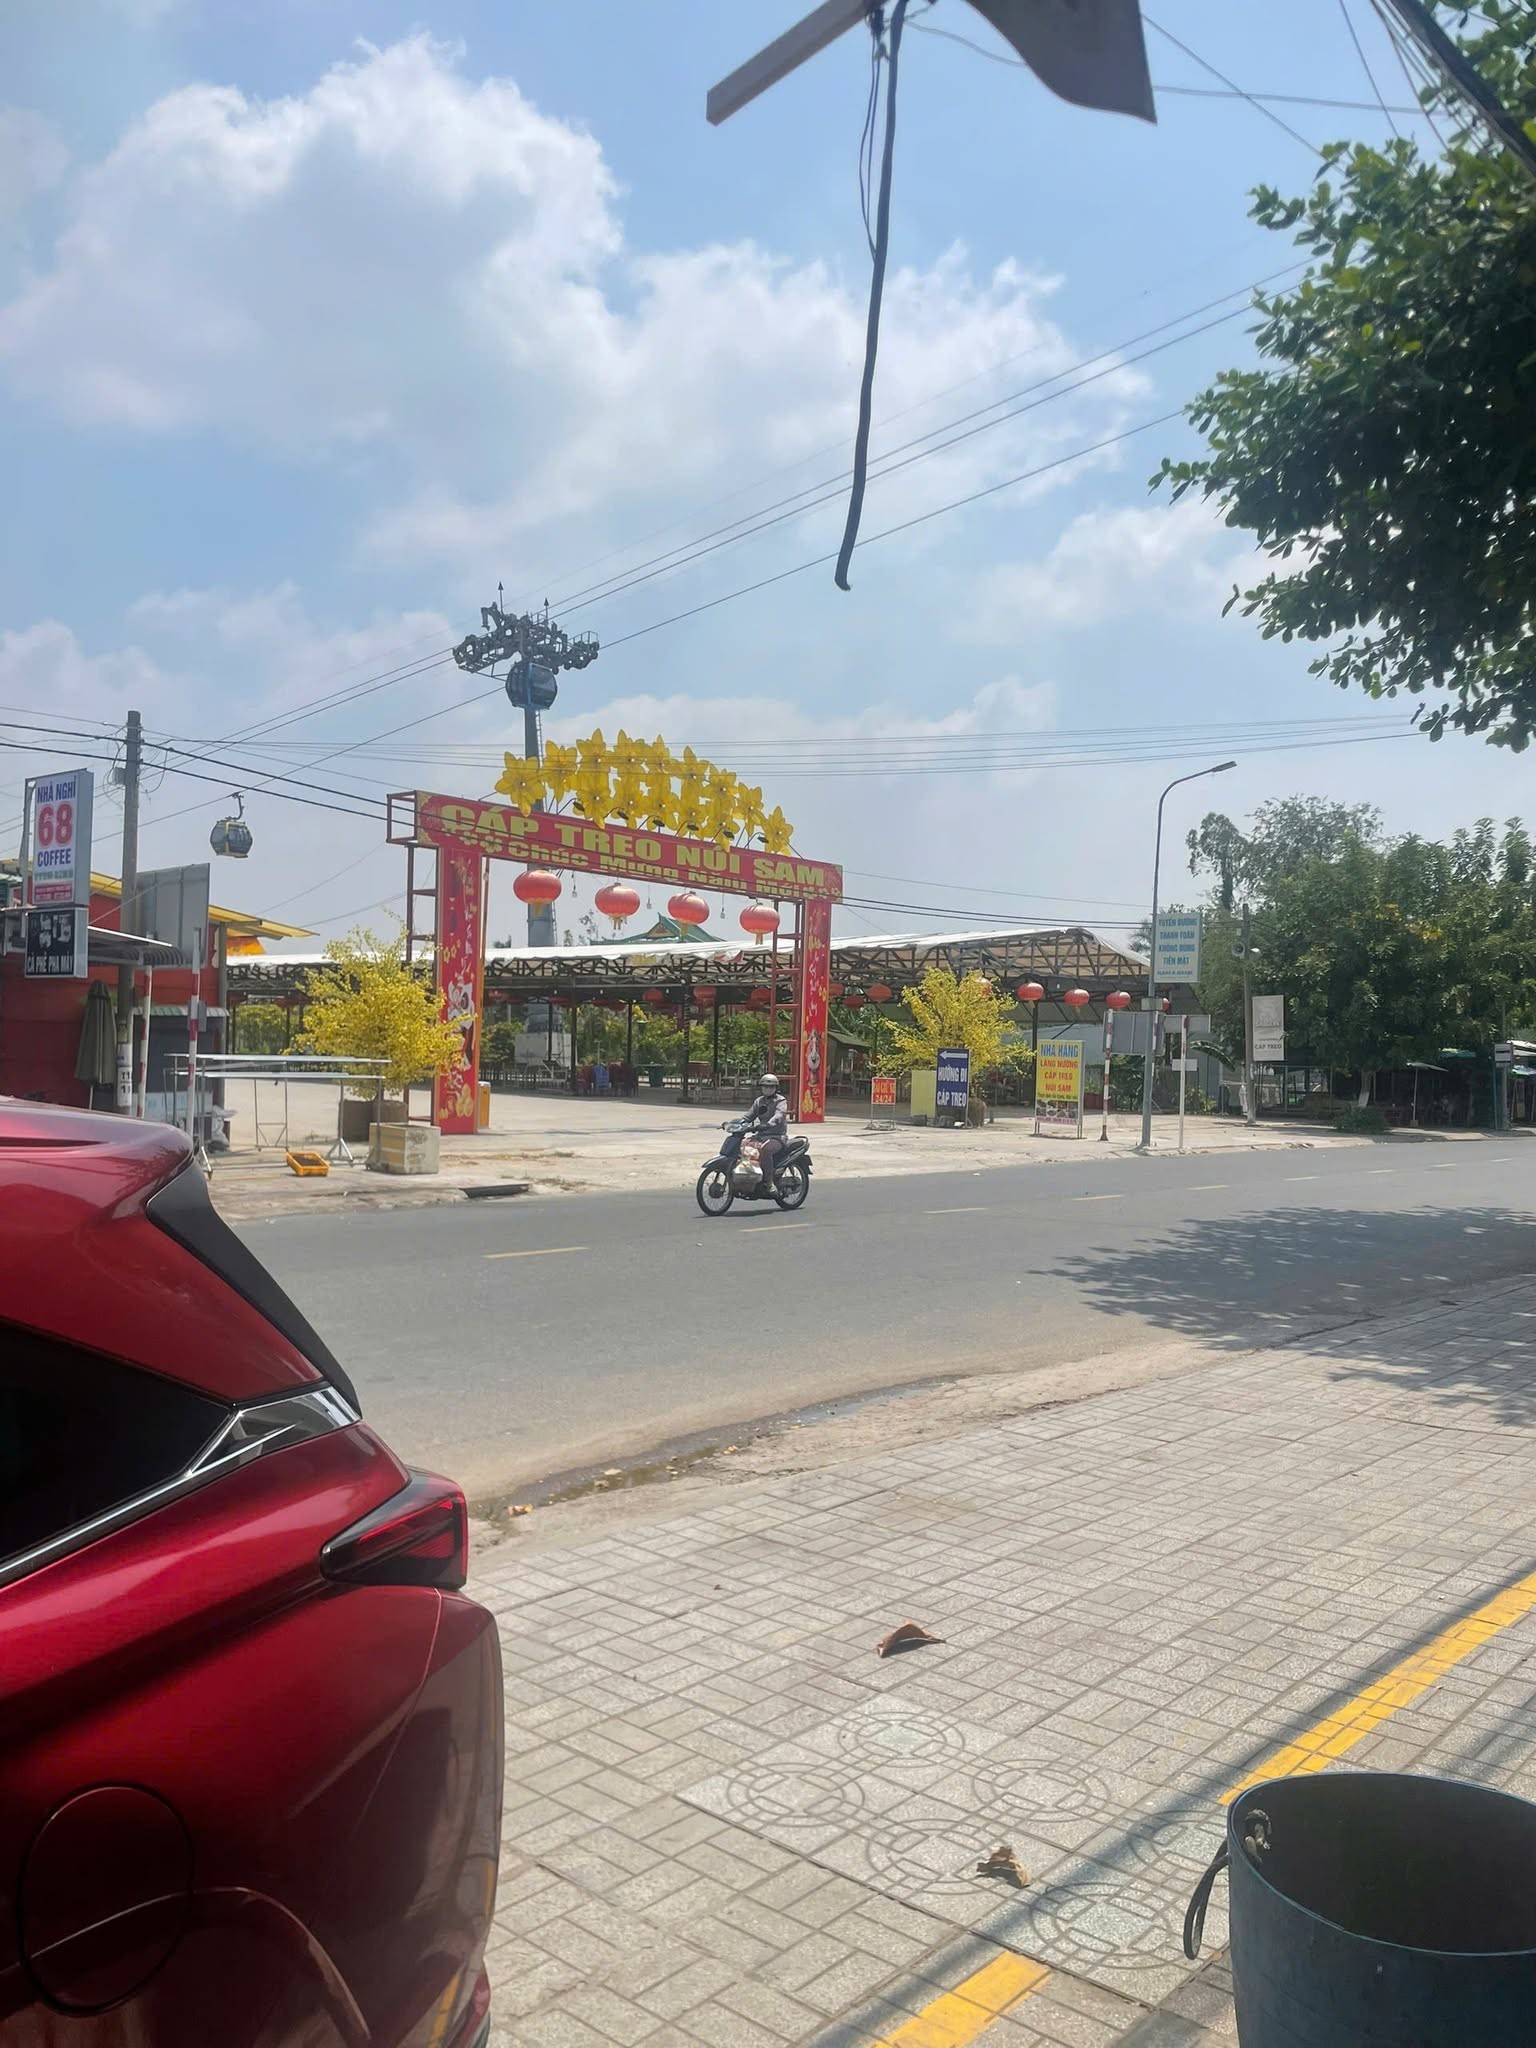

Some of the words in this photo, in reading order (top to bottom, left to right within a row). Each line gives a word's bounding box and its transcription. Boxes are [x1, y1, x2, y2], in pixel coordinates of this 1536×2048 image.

[37, 780, 53, 803] NHÀ
[38, 802, 73, 848] 68
[37, 848, 71, 867] COFFEE
[441, 804, 539, 839] CÁP
[555, 823, 662, 861] TREO
[753, 857, 825, 887] SAM
[508, 840, 589, 866] Chúc
[937, 1087, 950, 1106] CÁP
[951, 1091, 967, 1107] TREO
